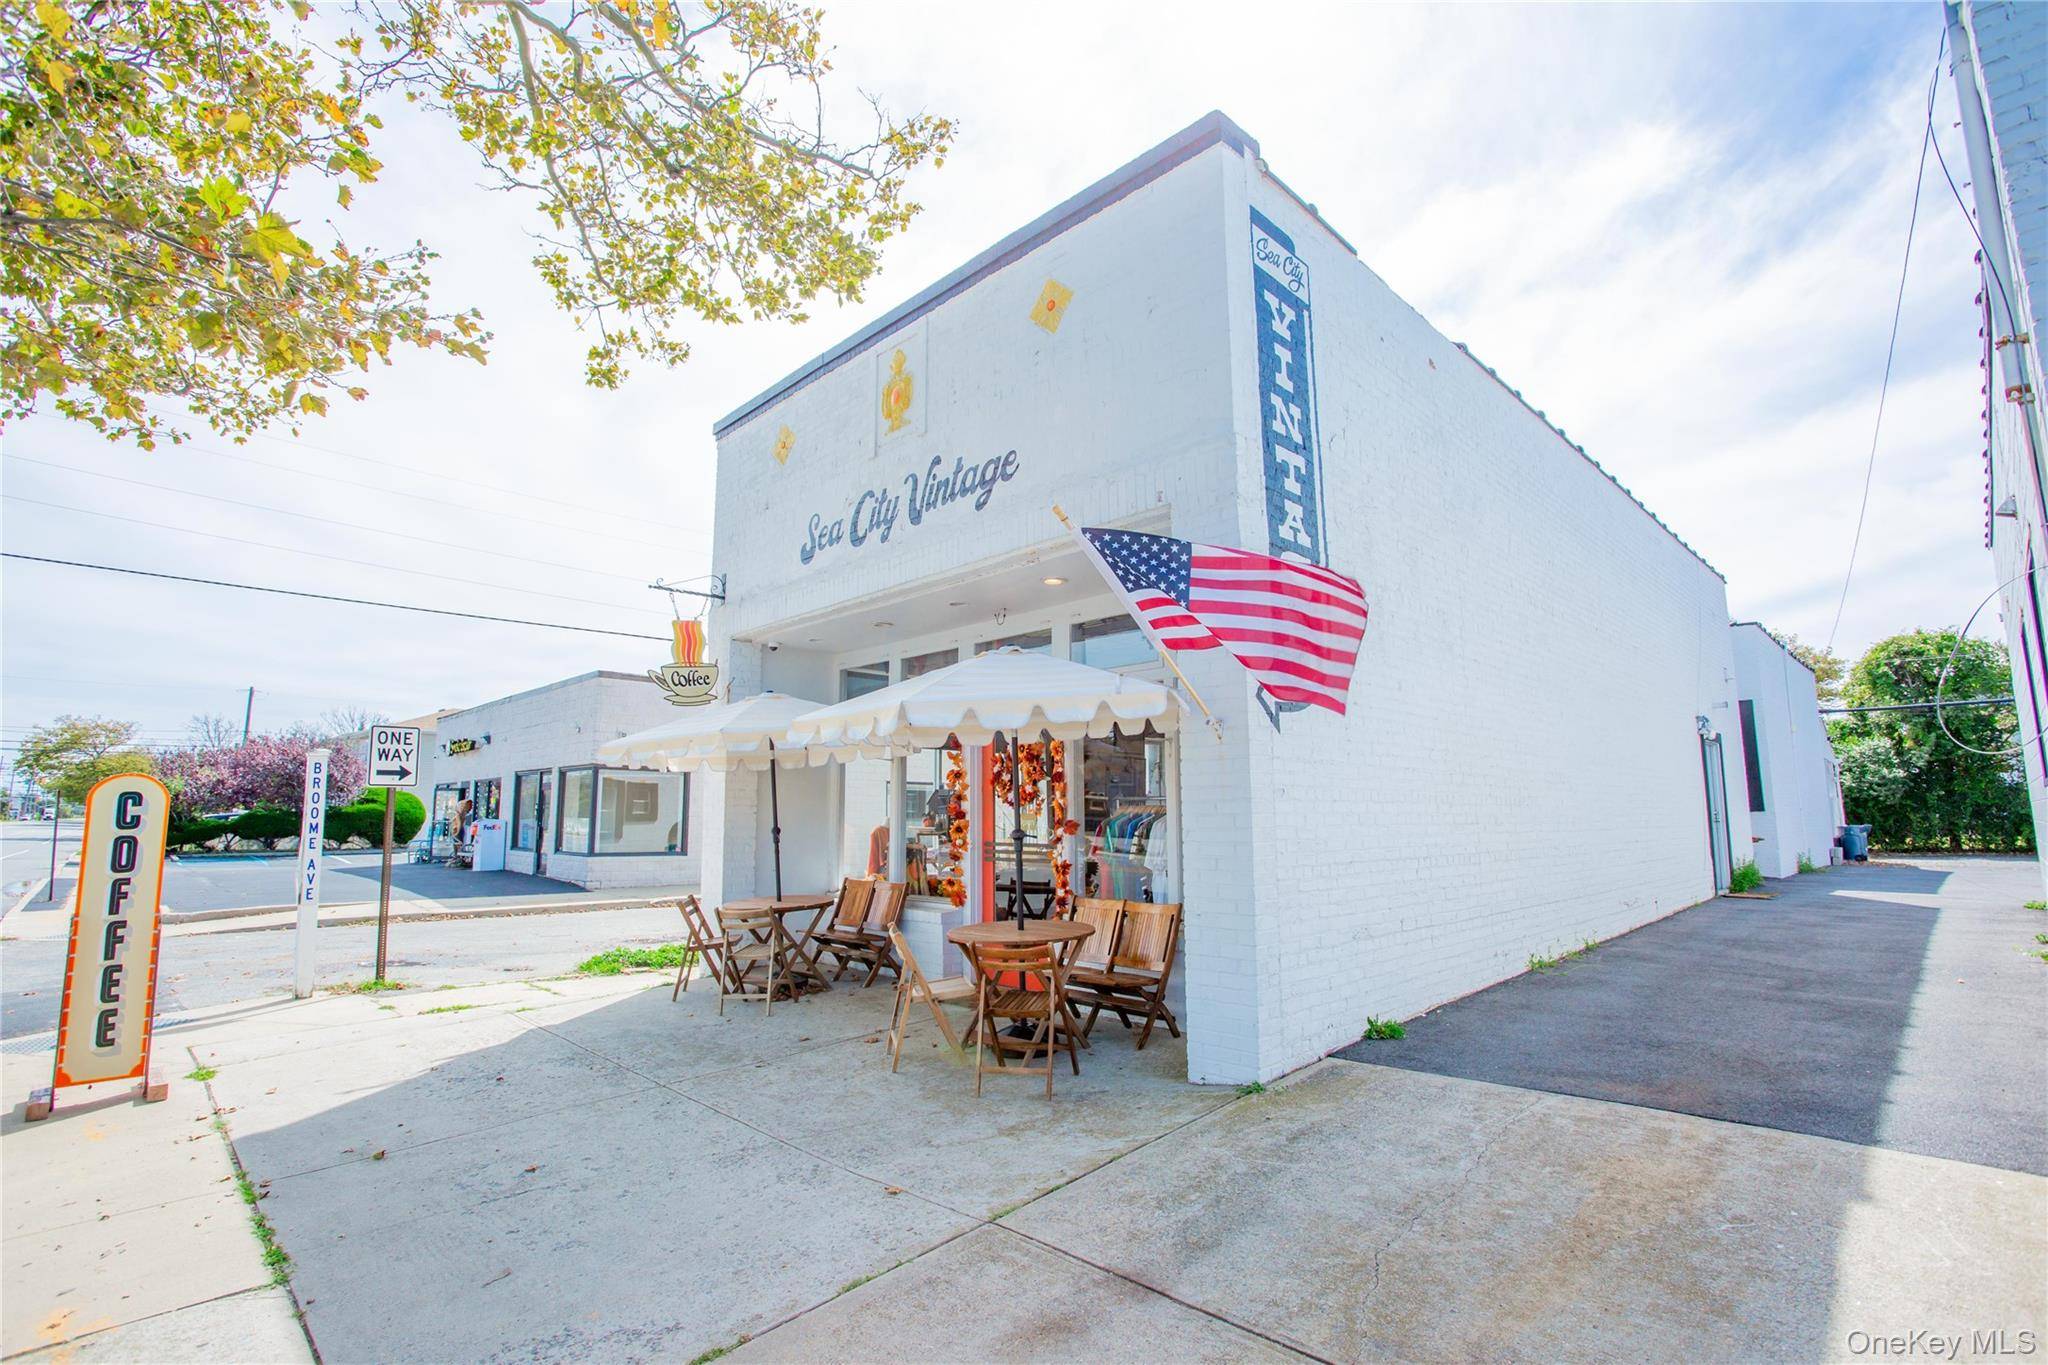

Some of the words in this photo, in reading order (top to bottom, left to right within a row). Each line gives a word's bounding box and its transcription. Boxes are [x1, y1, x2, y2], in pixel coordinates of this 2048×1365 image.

[1256, 238, 1281, 269] Sea
[1283, 256, 1305, 293] City
[1264, 288, 1313, 564] VINTA
[800, 512, 844, 565] Sea
[850, 488, 900, 547] City
[904, 449, 1020, 526] Vintage
[671, 670, 711, 687] Coffee
[377, 730, 413, 746] ONE
[377, 748, 414, 762] WAY
[308, 762, 322, 850] BROOME
[306, 859, 316, 901] AVE
[95, 791, 144, 1048] COFFEE
